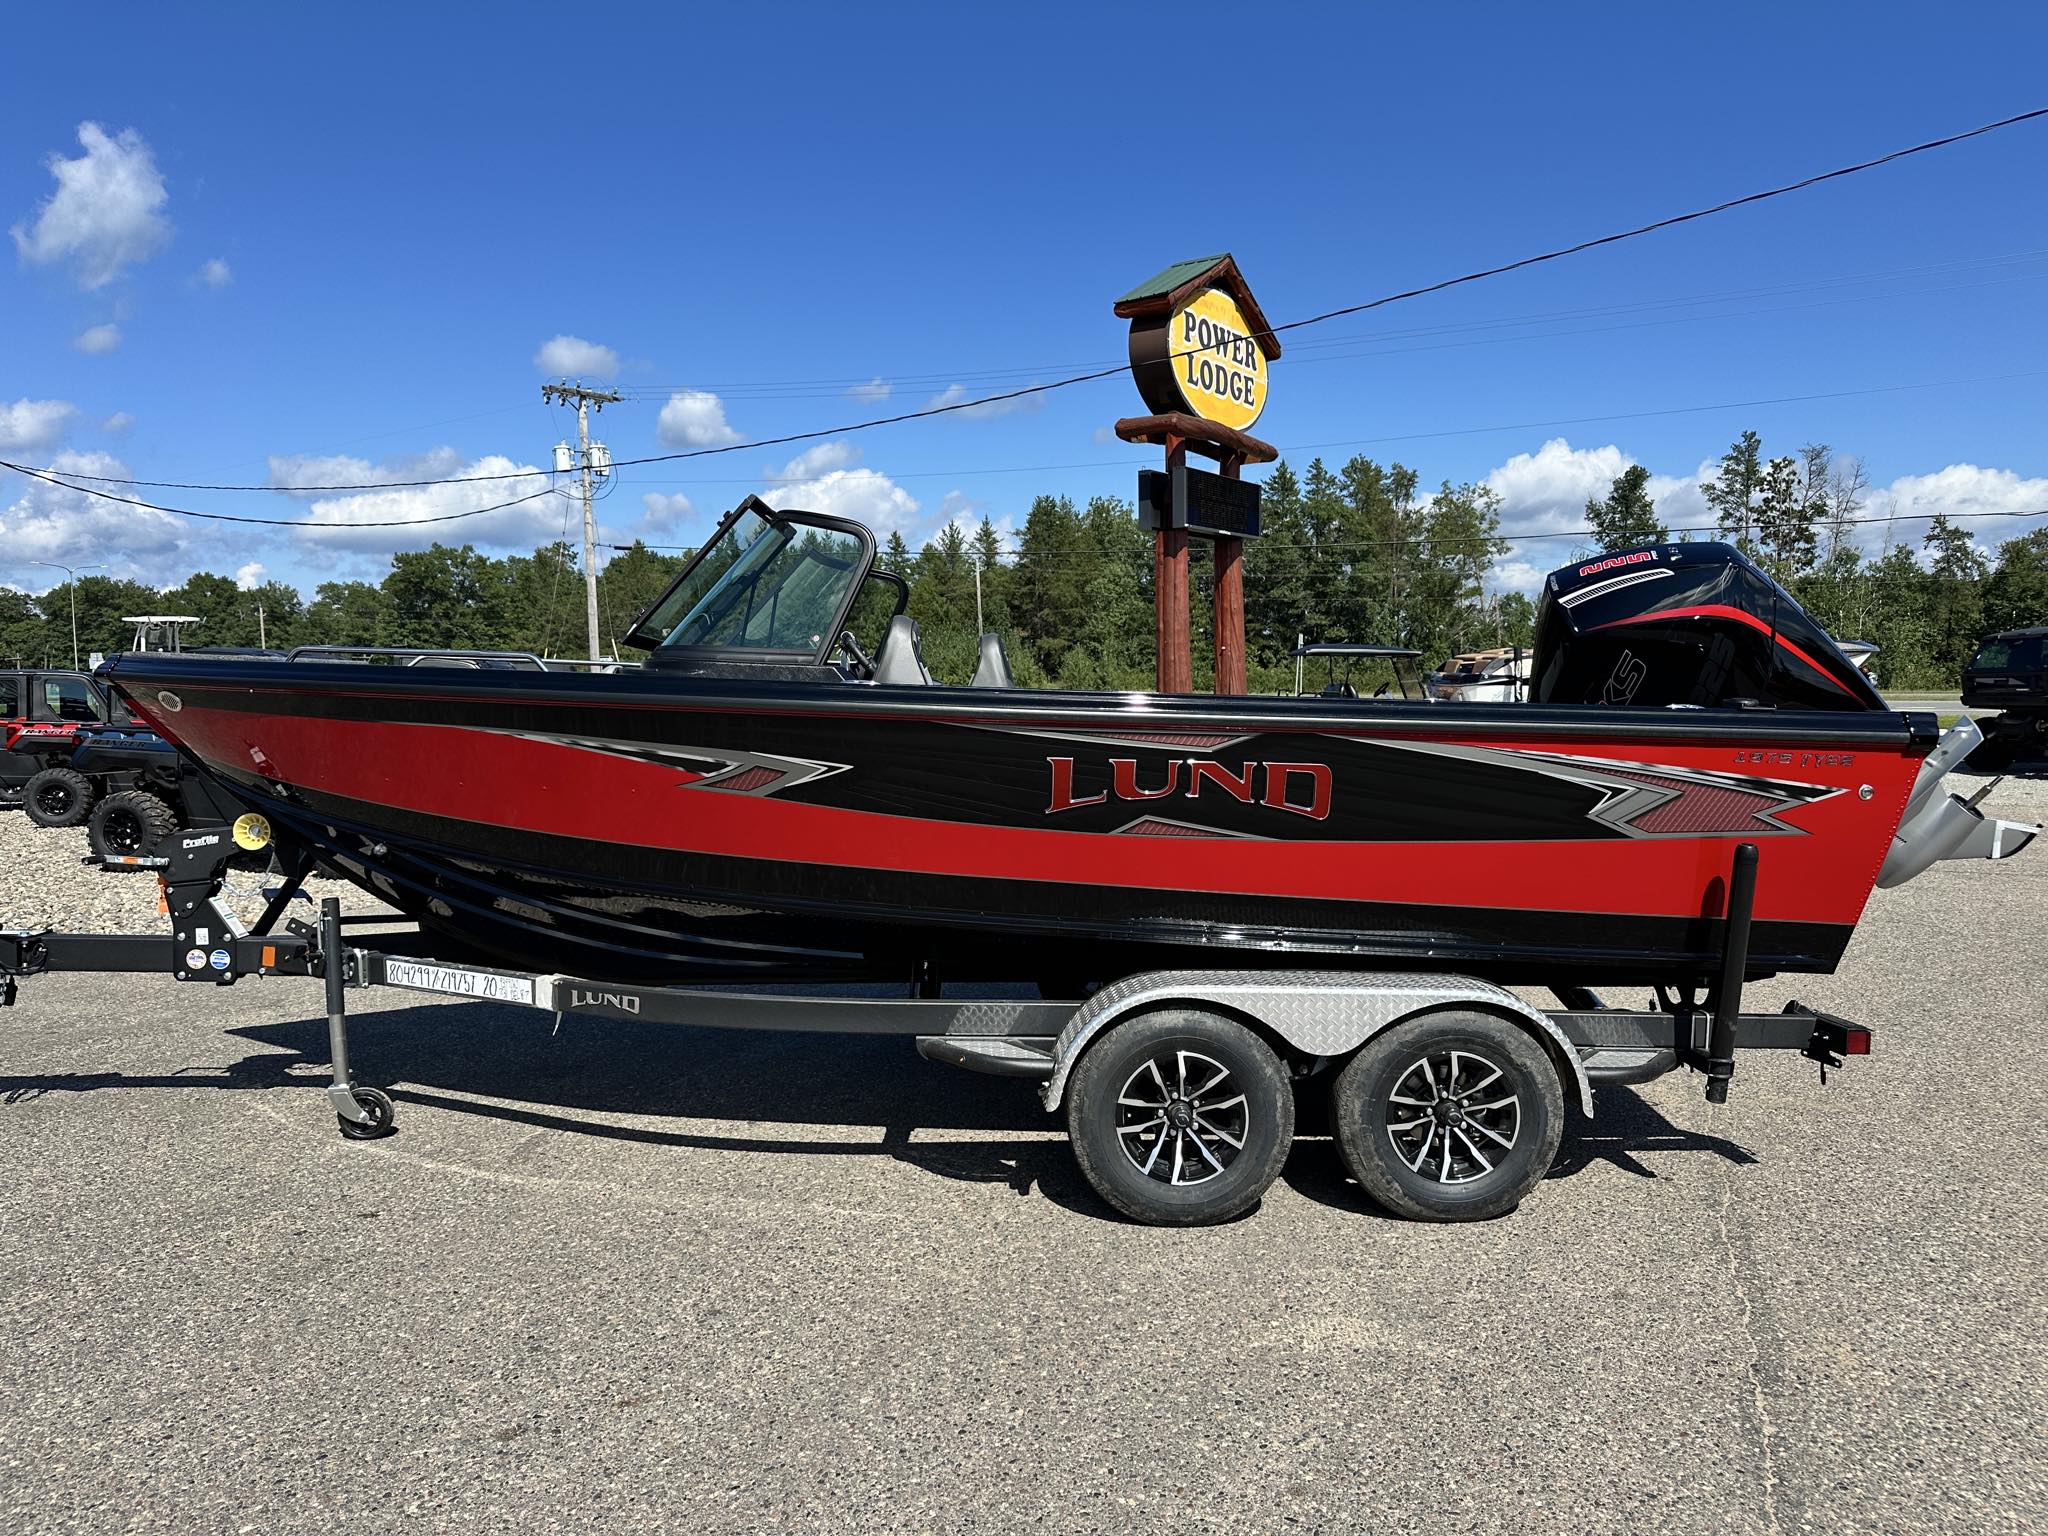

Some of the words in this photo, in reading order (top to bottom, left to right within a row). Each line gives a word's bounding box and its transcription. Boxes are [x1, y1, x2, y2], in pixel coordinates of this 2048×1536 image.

[1183, 310, 1257, 371] POWER
[1186, 353, 1254, 407] LODGE
[90, 738, 145, 748] RANGER
[1734, 751, 1792, 764] 1975
[1045, 756, 1332, 820] LUND
[183, 835, 219, 849] Profile
[483, 975, 498, 997] 20
[571, 989, 640, 1015] LUND
